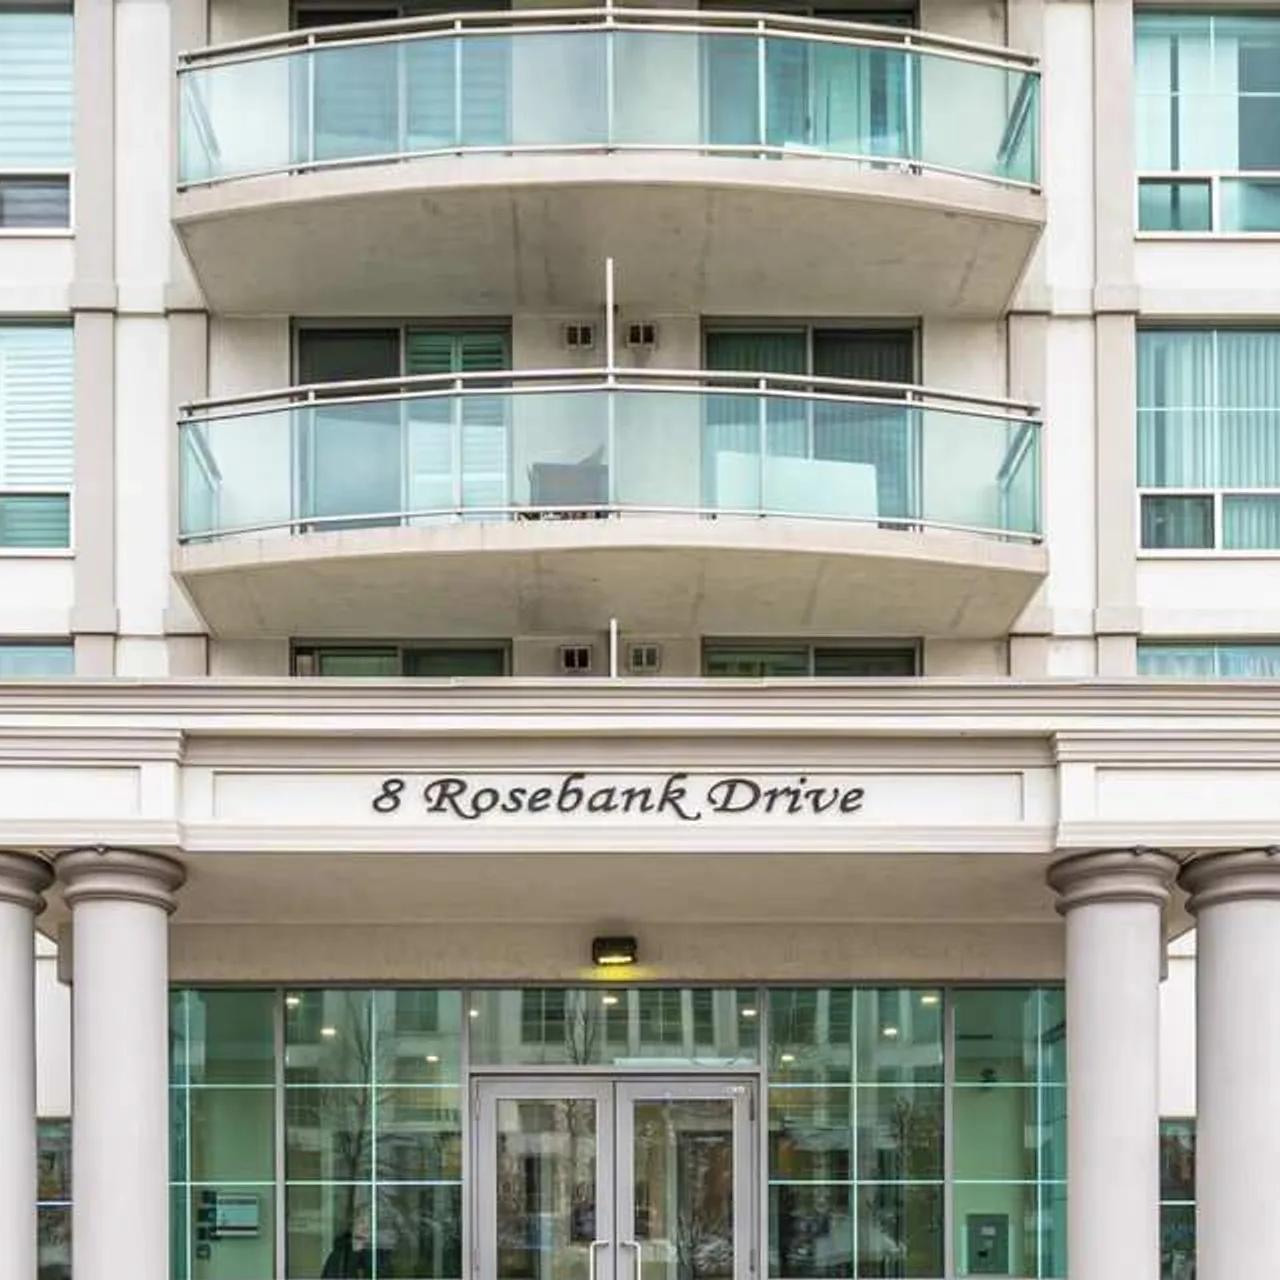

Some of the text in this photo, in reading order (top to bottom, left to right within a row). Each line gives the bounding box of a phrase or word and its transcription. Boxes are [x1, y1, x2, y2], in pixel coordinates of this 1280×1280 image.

[371, 771, 866, 821] 8 Rosebank Drive
